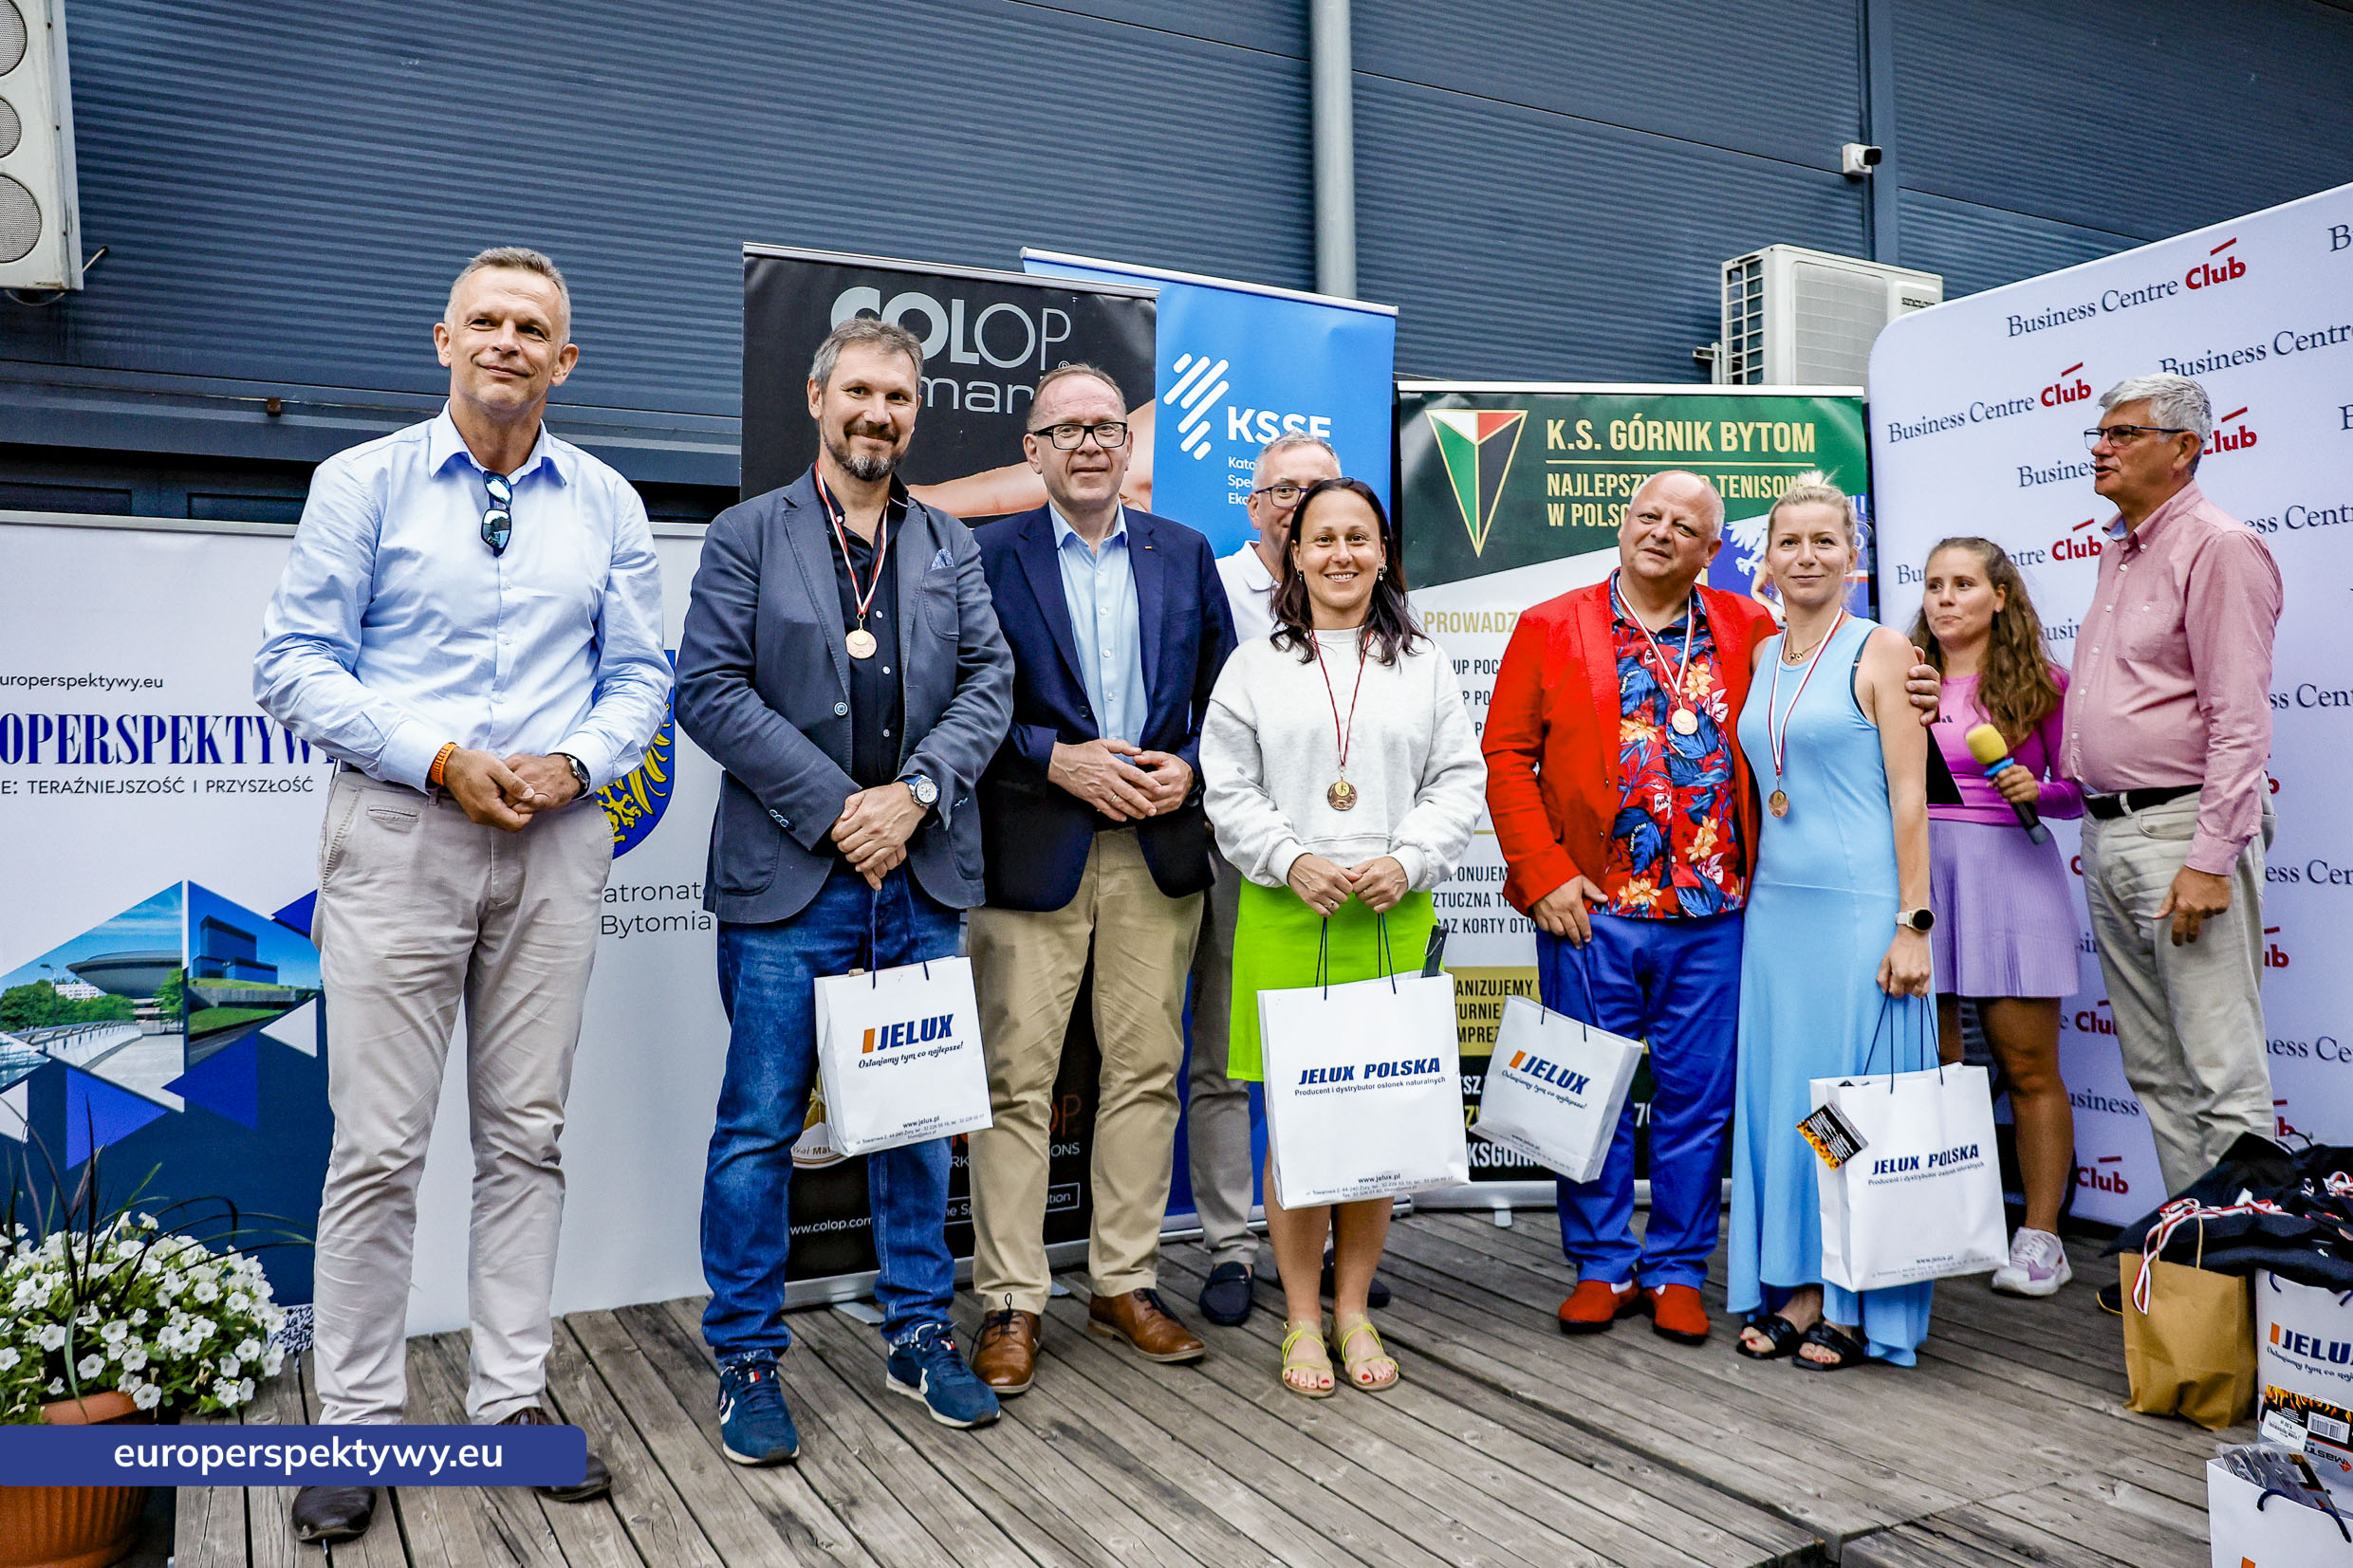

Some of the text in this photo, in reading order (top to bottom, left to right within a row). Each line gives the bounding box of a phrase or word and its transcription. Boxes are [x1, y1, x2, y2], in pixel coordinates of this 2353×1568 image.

[2007, 256, 2246, 337] Business Centre Club
[2158, 325, 2353, 377] Business Centr
[920, 376, 1043, 414] mar
[1887, 379, 2091, 443] Business Centre Club
[1547, 413, 1815, 452] K.S. GÓRNIK BYTOM
[1228, 456, 1255, 470] Kato
[2017, 457, 2097, 488] Busines
[1547, 504, 1566, 526] W
[2286, 504, 2353, 529] Cent
[2052, 536, 2103, 561] Club
[1424, 612, 1518, 633] PROWADZ
[0, 673, 163, 691] uroperspektywy.eu
[0, 713, 334, 765] OPERSPEKTYW
[27, 777, 185, 794] TERAŹNIEJSZOŚĆ
[194, 780, 197, 793] I
[206, 775, 314, 793] PRZYSZŁOŚĆ
[603, 881, 702, 903] atronat
[1433, 893, 1491, 908] ZTUCZNA
[601, 910, 712, 939] Bytomia
[1463, 918, 1505, 933] KORTY
[1510, 918, 1537, 933] OTW
[1456, 980, 1533, 996] ANIZUJEMY
[1456, 1004, 1501, 1020] URNIE
[2075, 1011, 2118, 1036] Clu
[878, 1014, 954, 1050] JELUX
[900, 1053, 916, 1063] tym
[1299, 1057, 1440, 1085] JELUX POLSKA
[1521, 1055, 1590, 1095] JELUX
[1295, 1087, 1330, 1096] Producent
[1335, 1083, 1376, 1095] dystrybutor
[1405, 1076, 1446, 1086] naturalnych
[2070, 1089, 2140, 1116] usiness
[1050, 1142, 1081, 1156] ONS
[1872, 1143, 1979, 1174] JELUX POLSKA
[1048, 1192, 1071, 1204] tion
[2282, 1328, 2353, 1365] JELU
